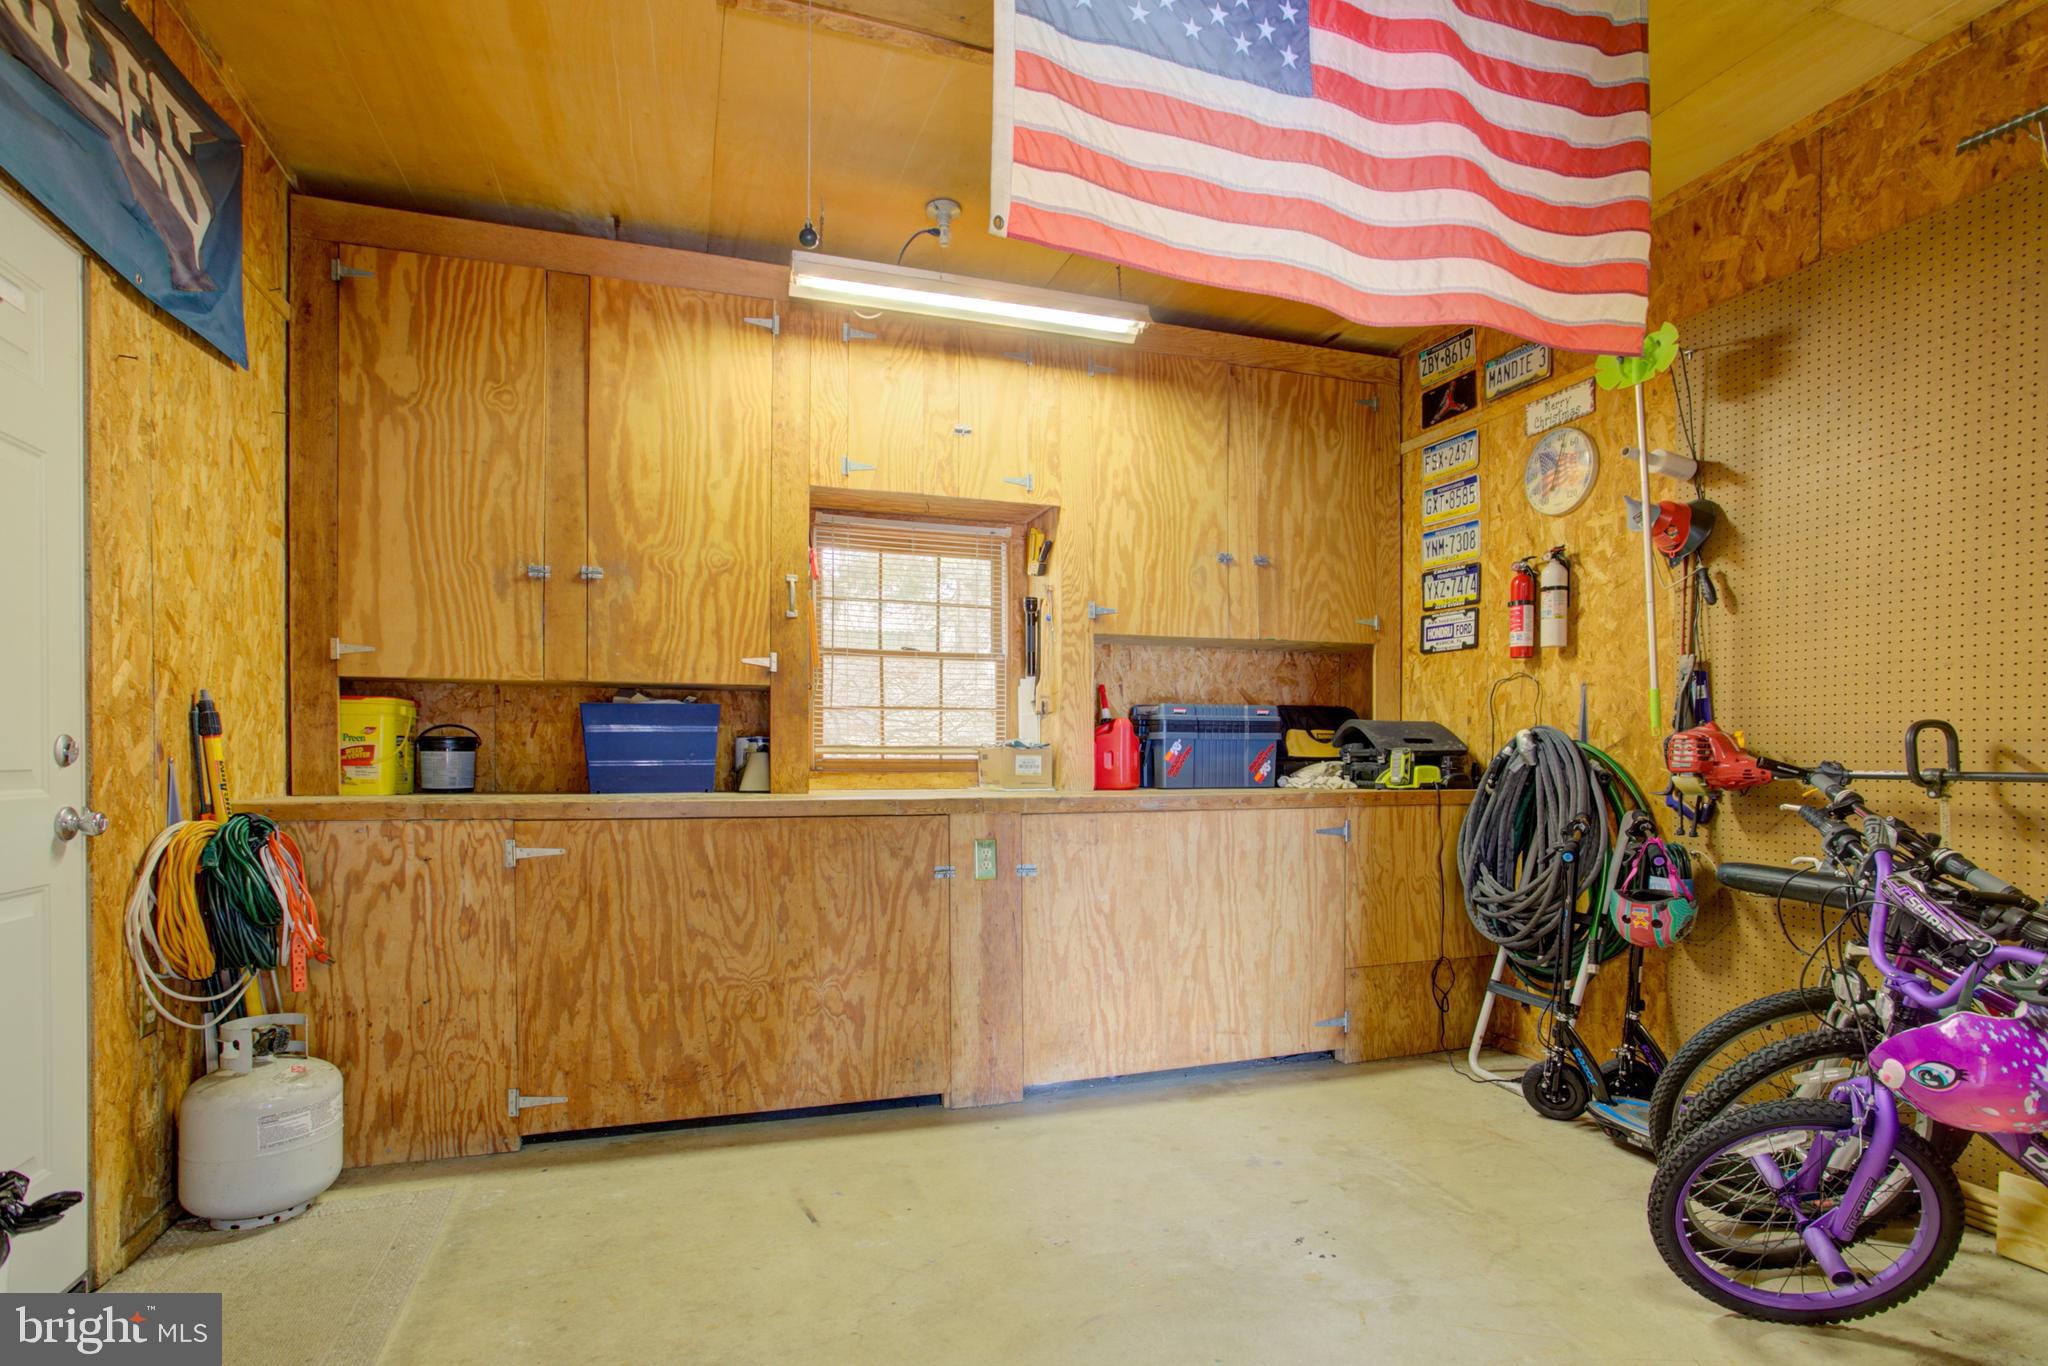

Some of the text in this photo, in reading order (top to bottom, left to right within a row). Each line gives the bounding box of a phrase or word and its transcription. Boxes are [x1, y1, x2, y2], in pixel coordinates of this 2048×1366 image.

[1488, 353, 1533, 390] MANDIE
[1539, 347, 1546, 368] 3
[1544, 395, 1572, 413] Merry
[1534, 405, 1581, 429] Christmas
[1455, 623, 1472, 635] FORD
[342, 733, 366, 742] Preen
[1894, 882, 1951, 936] INSPIRE
